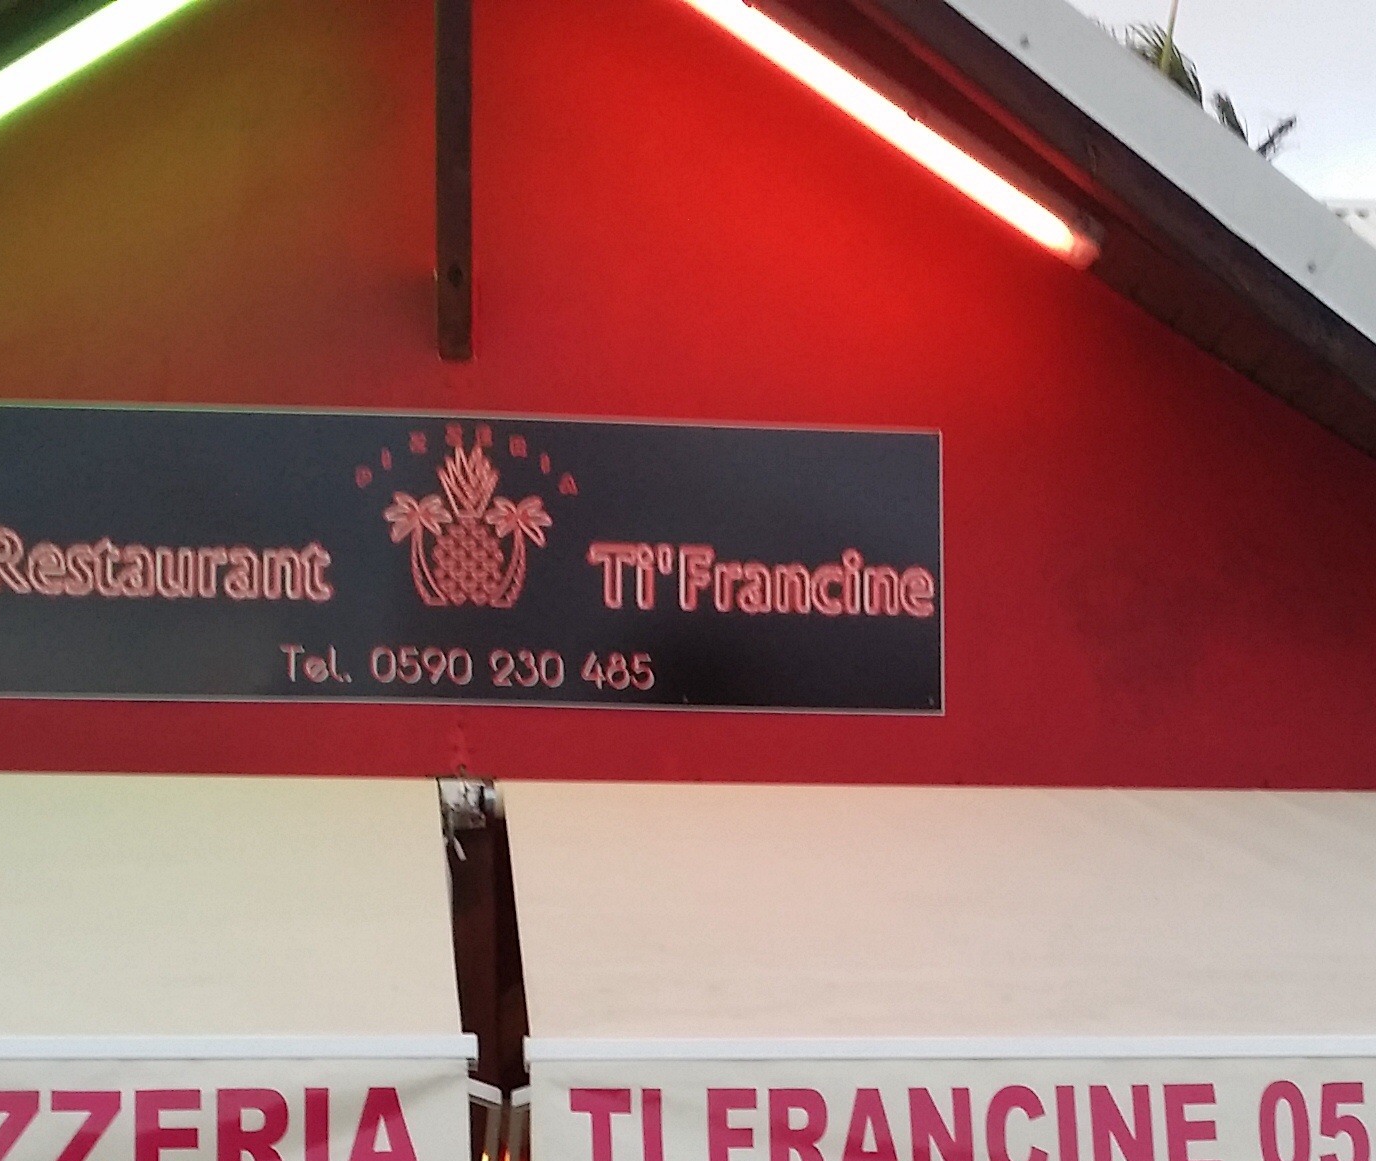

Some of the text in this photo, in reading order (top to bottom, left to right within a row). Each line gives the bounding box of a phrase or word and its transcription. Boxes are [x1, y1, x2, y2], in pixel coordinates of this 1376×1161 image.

[587, 540, 936, 617] Ti'Francine
[280, 643, 656, 691] Tel. 0590 230 485
